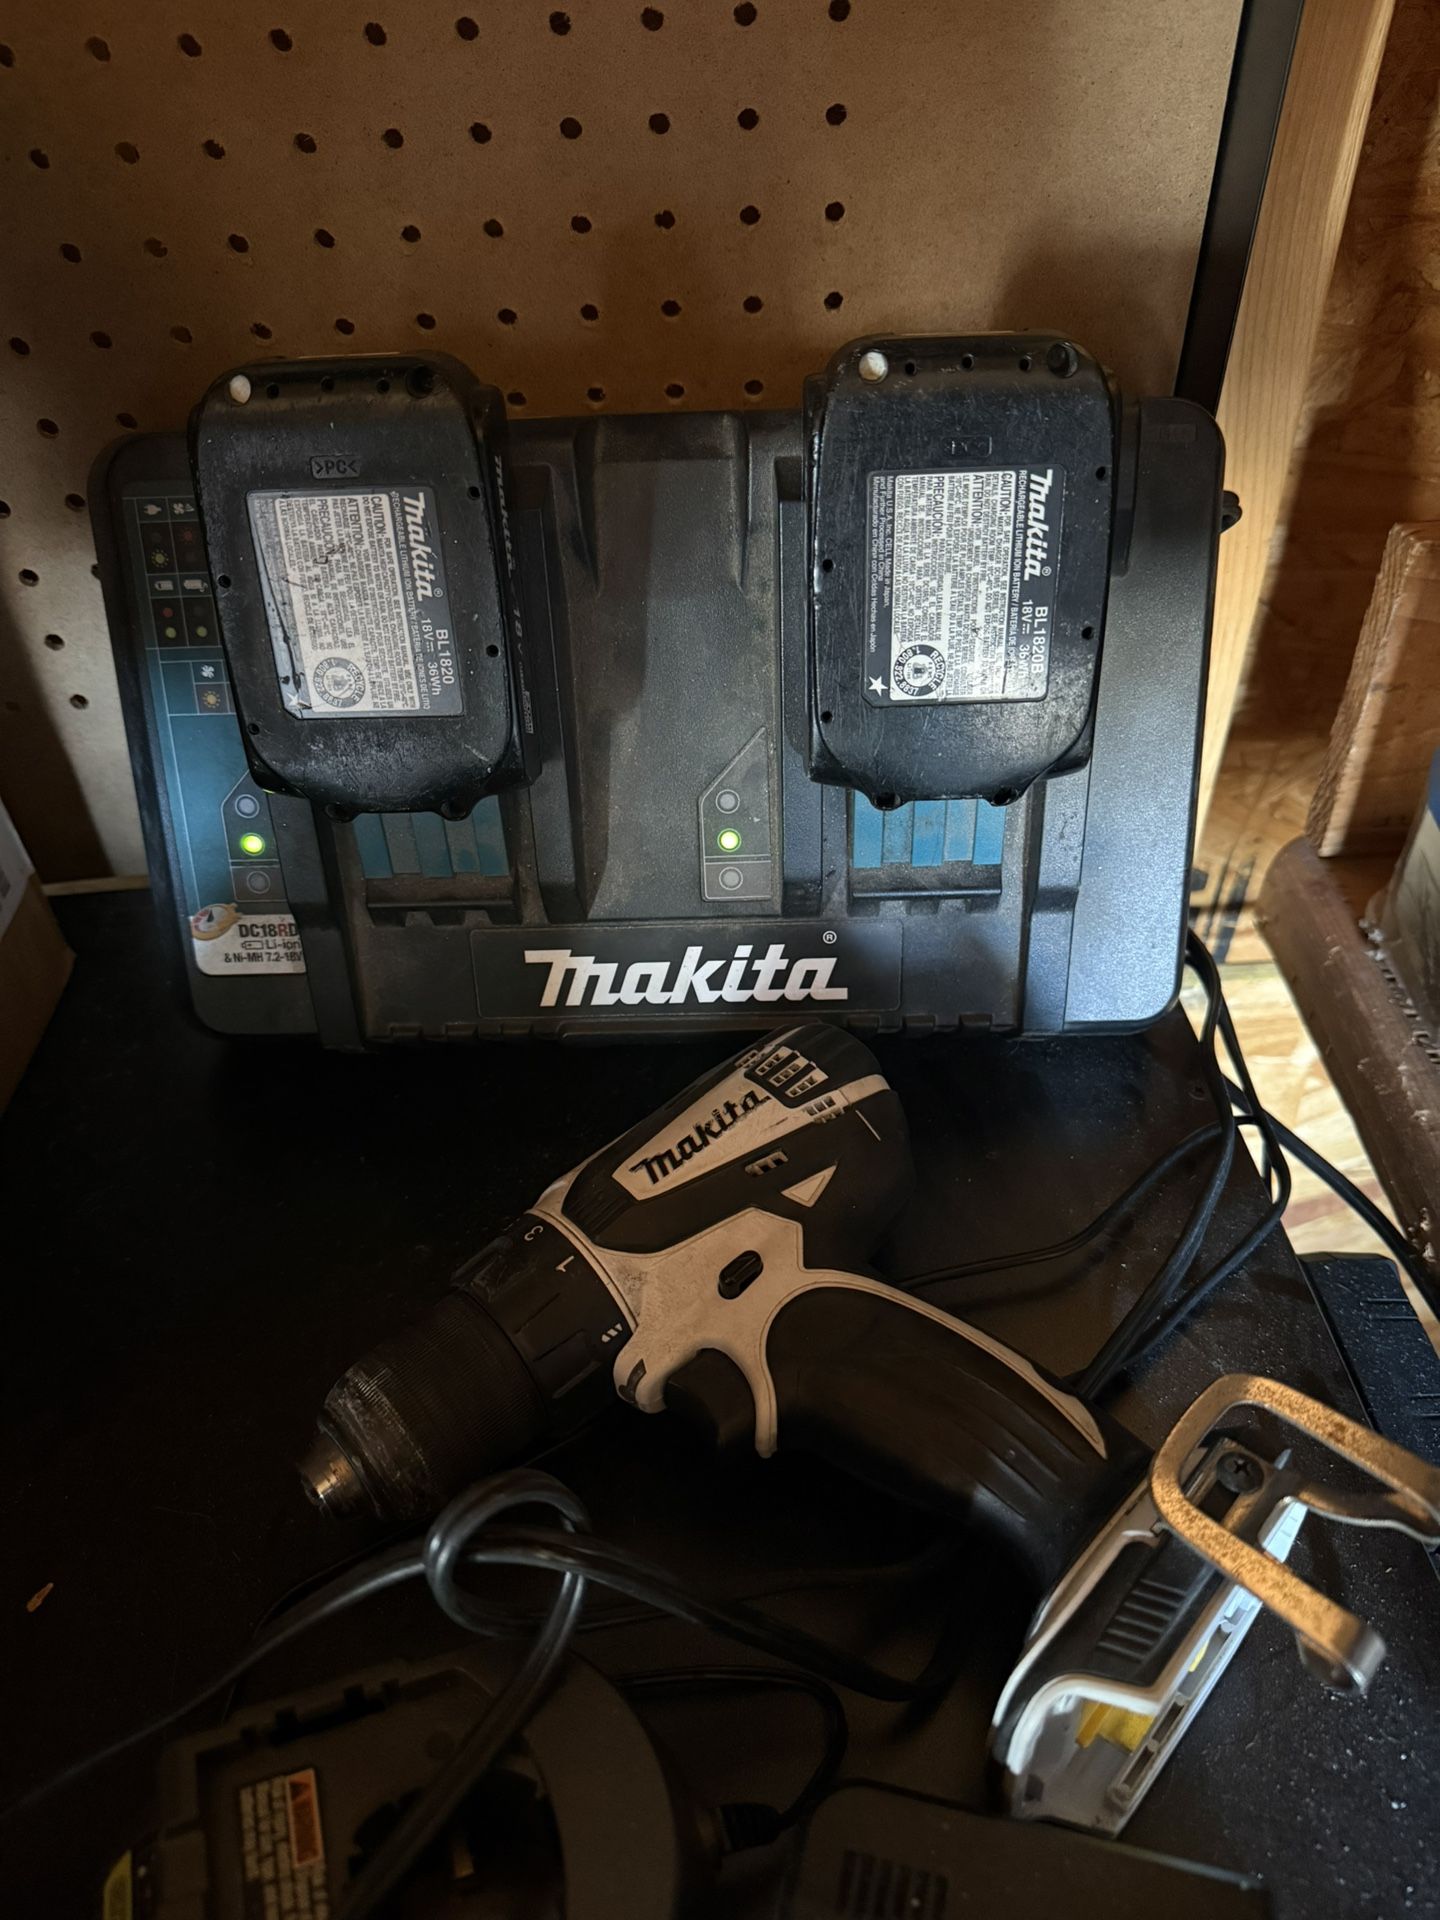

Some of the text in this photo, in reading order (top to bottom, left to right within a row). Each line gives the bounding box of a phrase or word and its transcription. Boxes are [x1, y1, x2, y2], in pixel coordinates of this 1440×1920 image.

[970, 474, 984, 527] ATTENTION:
[998, 472, 1013, 515] CAUTION:
[1015, 470, 1027, 527] RECHARGEABLE
[346, 497, 366, 548] ATTENTION:
[370, 496, 387, 537] CAUTION:
[1014, 529, 1023, 557] LITHIUM
[1013, 558, 1021, 570] ION
[1011, 572, 1021, 602] BATTERY
[435, 629, 454, 683] BL1820
[1030, 606, 1047, 673] BL1820B
[426, 662, 441, 695] 36Wh
[927, 650, 945, 689] RECYCLE
[1017, 644, 1029, 678] 36Wh
